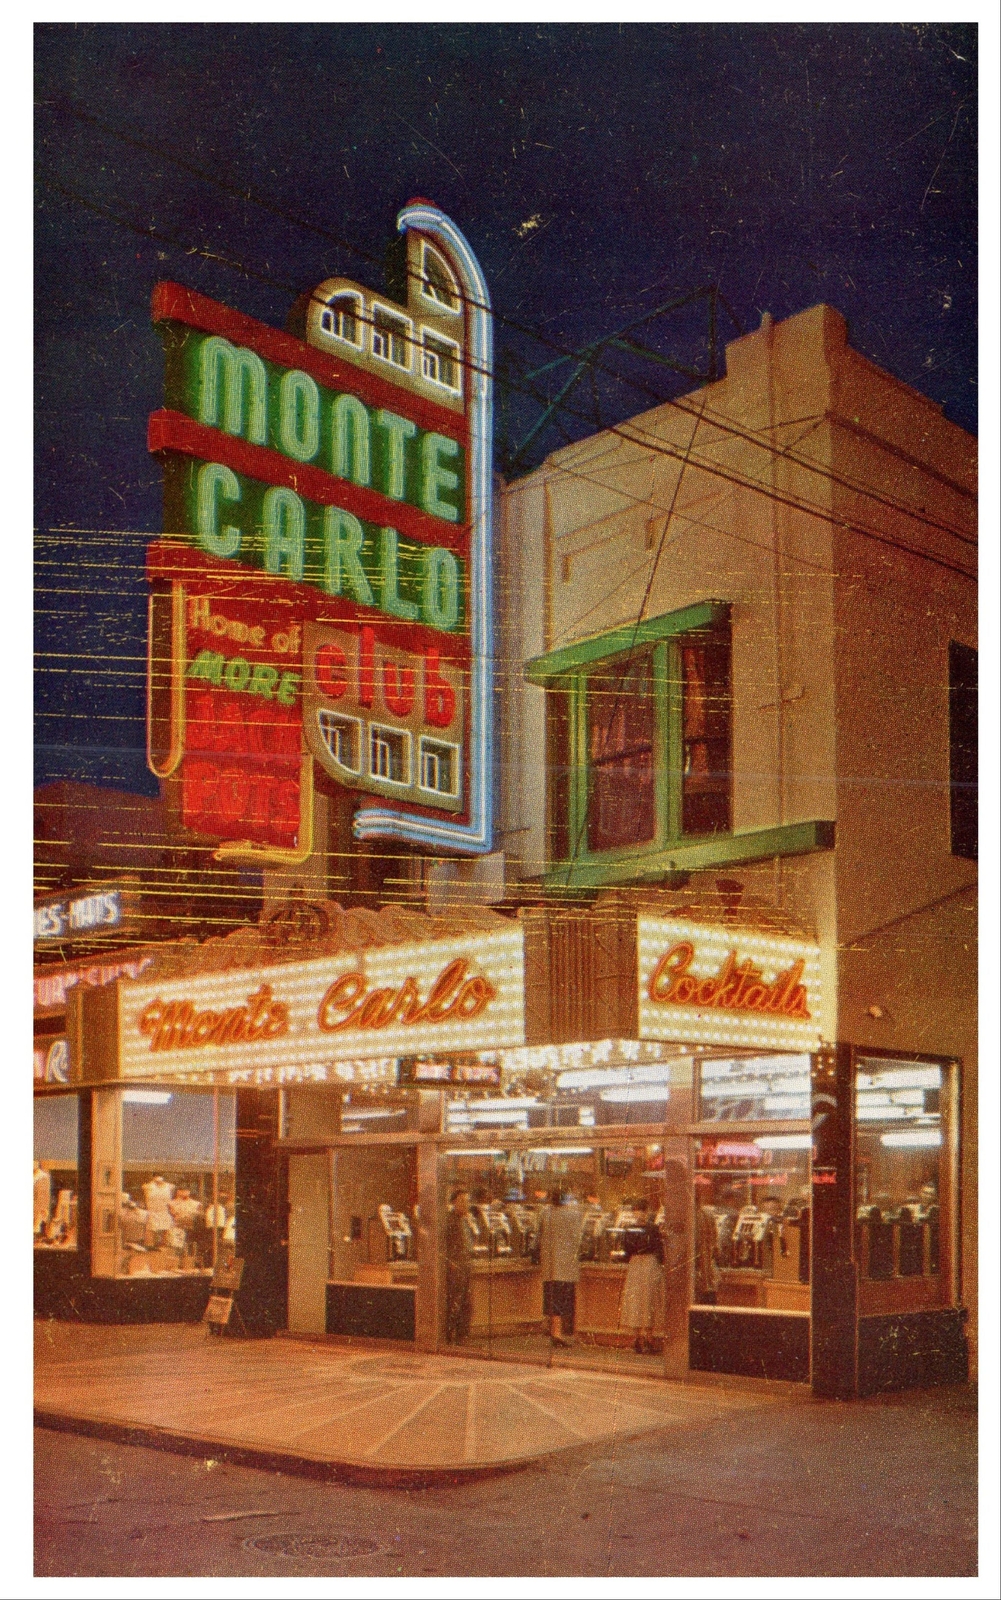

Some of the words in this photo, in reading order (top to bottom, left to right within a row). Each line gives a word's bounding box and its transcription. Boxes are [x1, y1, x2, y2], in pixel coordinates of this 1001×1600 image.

[199, 335, 460, 522] MONTE
[196, 461, 460, 631] CARLO
[186, 597, 266, 647] Home
[271, 622, 302, 653] of
[187, 649, 302, 706] MORE
[181, 761, 303, 833] POTS
[138, 983, 290, 1052] Monte
[316, 957, 495, 1034] Carlo
[649, 940, 812, 1020] Cocktails
